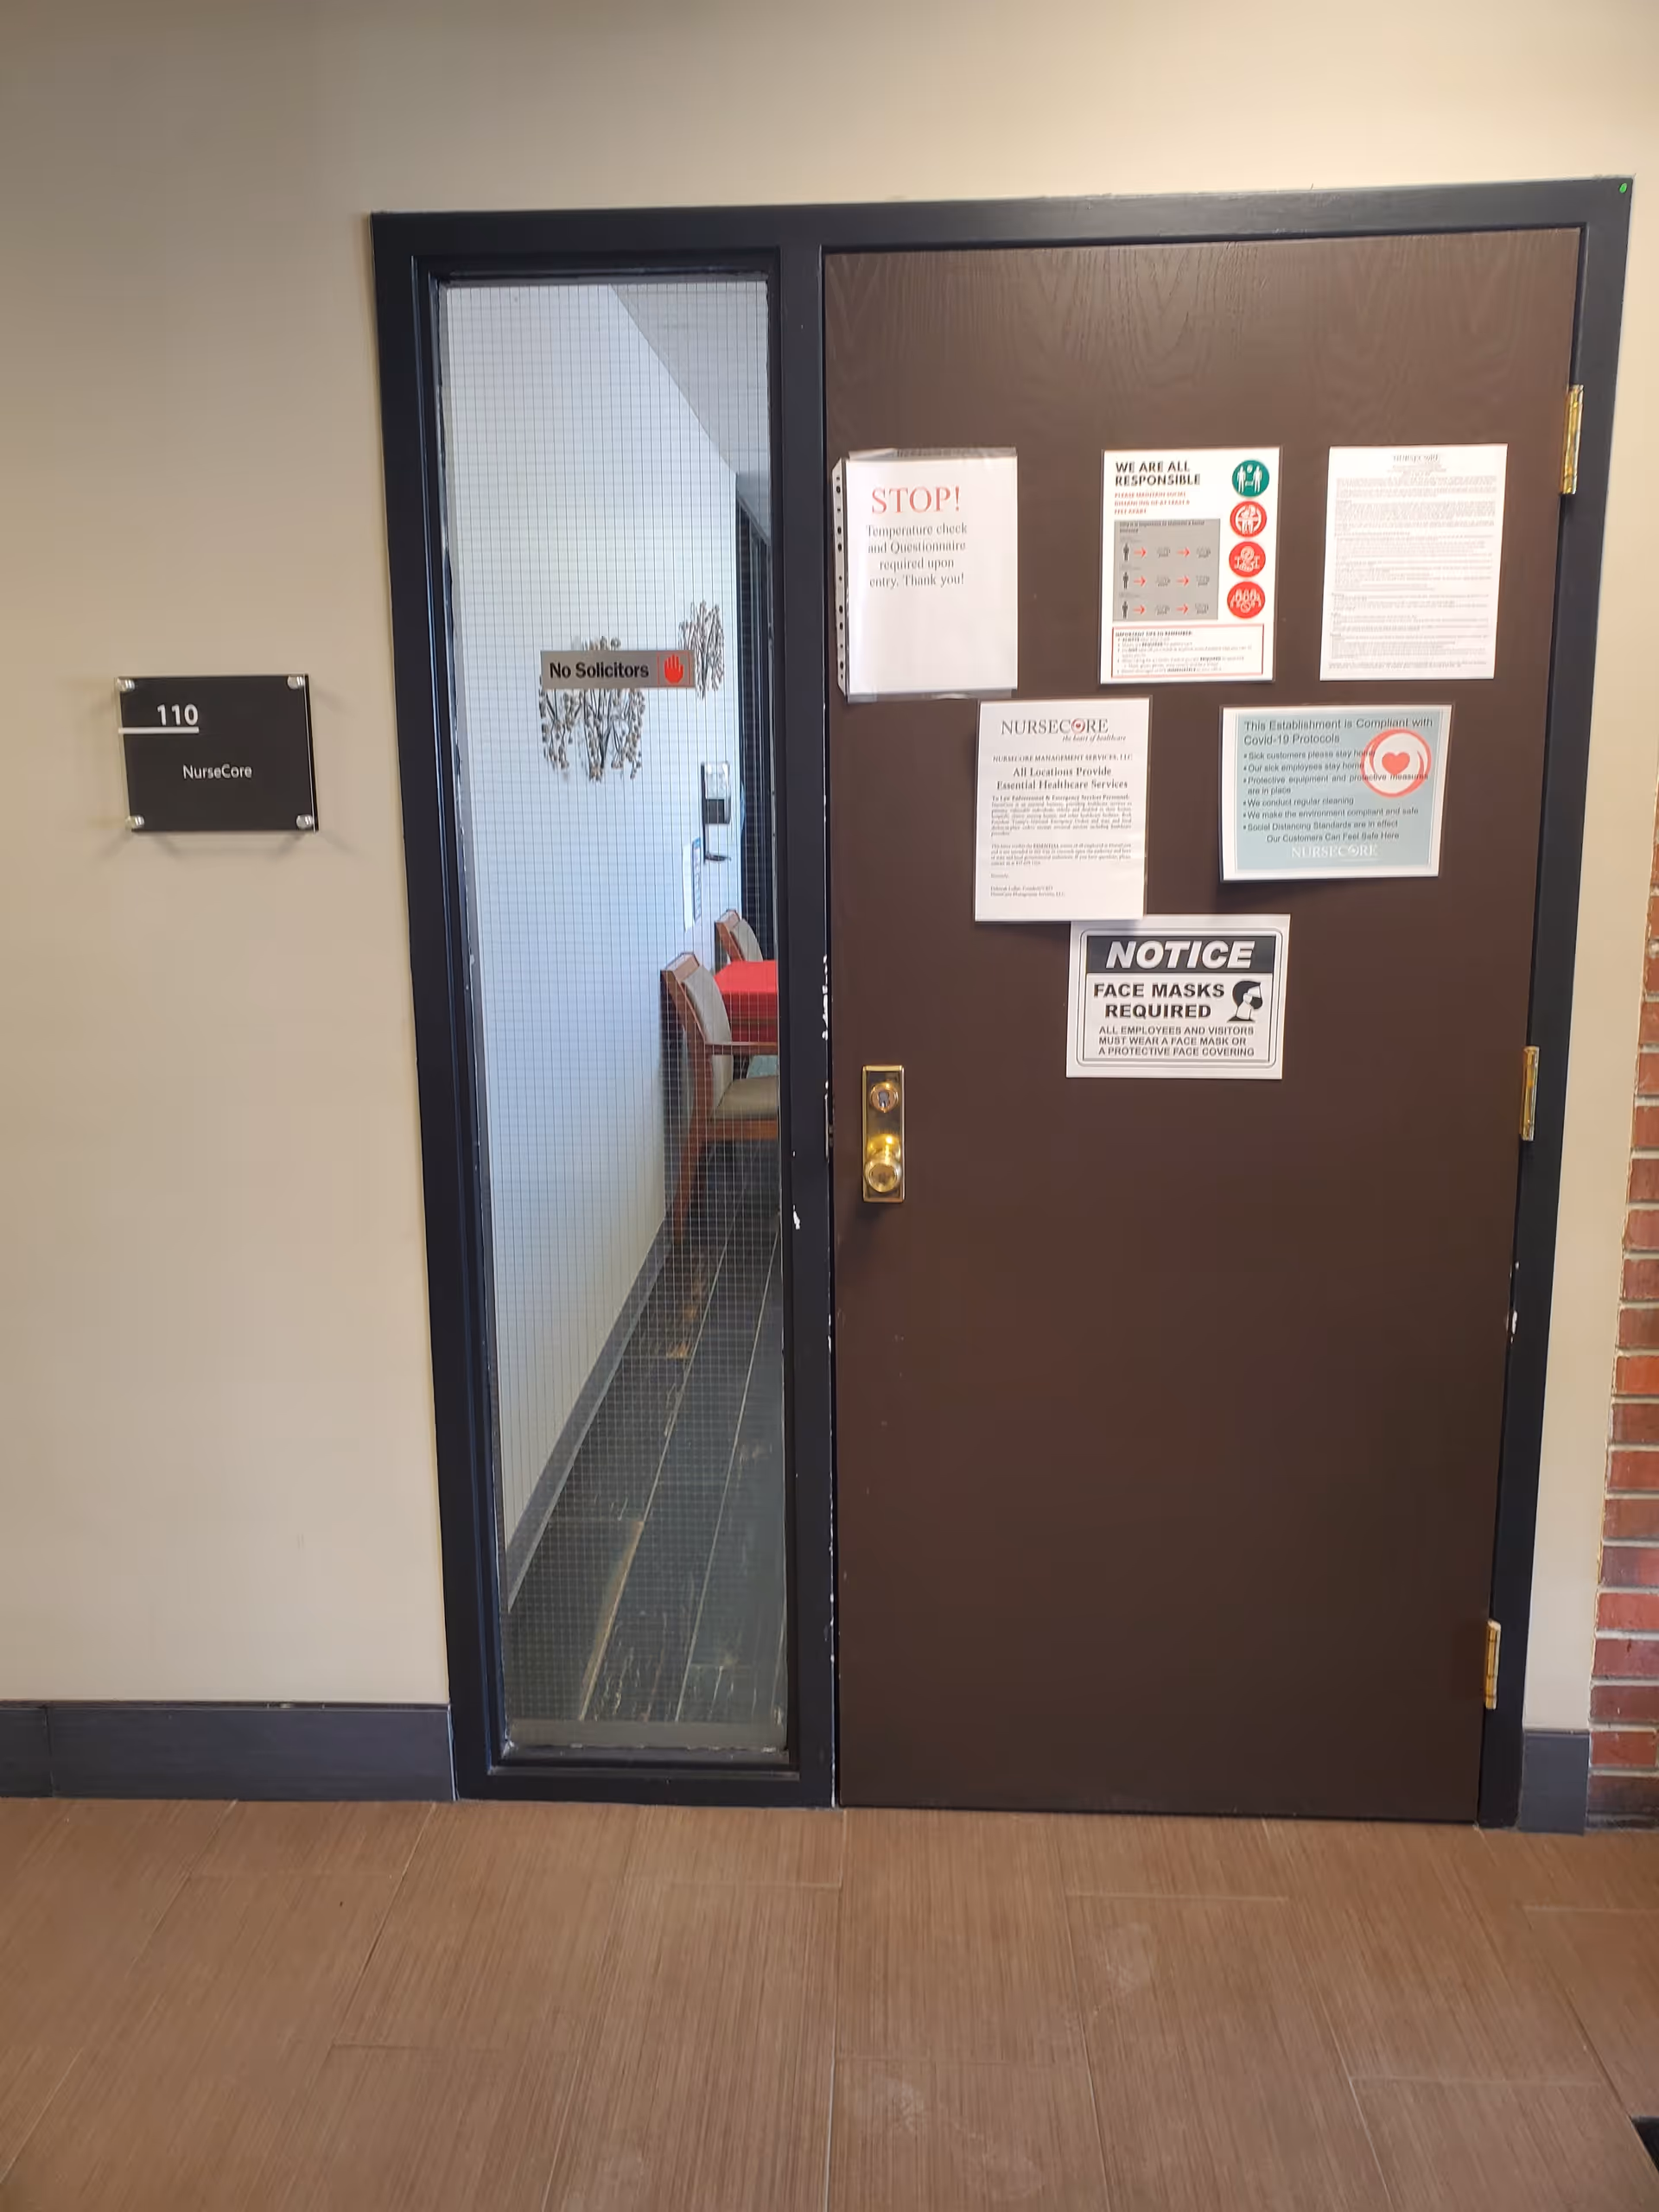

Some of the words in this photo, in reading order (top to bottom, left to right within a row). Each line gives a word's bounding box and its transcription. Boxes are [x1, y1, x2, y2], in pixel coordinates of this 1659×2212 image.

[1116, 461, 1135, 473] WE
[1139, 461, 1163, 473] ARE
[1167, 460, 1190, 472] ALL
[1116, 474, 1200, 486] RESPONSIBLE
[872, 486, 960, 514] STOP!
[866, 524, 932, 539] Temperature
[936, 522, 967, 534] check
[868, 542, 887, 553] and
[890, 540, 966, 554] Questionnaire
[880, 557, 924, 572] required
[928, 558, 954, 571] upon
[869, 575, 899, 588] entry.
[903, 575, 936, 586] Thank
[940, 573, 964, 588] you!
[550, 663, 571, 678] No
[575, 662, 649, 678] Solicitors
[157, 703, 199, 726] 110
[1001, 718, 1109, 735] NURSECORE
[1244, 720, 1266, 731] This
[1269, 719, 1341, 731] Establishment
[1344, 719, 1352, 728] is
[1356, 718, 1408, 731] Compliant
[1412, 718, 1433, 728] with
[1244, 734, 1289, 746] Covid-19
[1293, 733, 1340, 745] Protocols
[1267, 751, 1306, 760] customers
[1308, 750, 1333, 760] please
[182, 763, 253, 779] NurseCore
[1013, 767, 1027, 777] All
[1030, 766, 1073, 777] Locations
[1077, 766, 1112, 777] Provide
[1249, 763, 1262, 772] Our
[1281, 763, 1322, 772] employees
[1325, 762, 1340, 772] stay
[997, 780, 1035, 791] Essential
[1039, 779, 1089, 790] Healthcare
[1091, 779, 1128, 789] Services
[1249, 776, 1285, 785] Protective
[1289, 775, 1328, 785] equipment
[1349, 773, 1387, 783] protective
[1270, 786, 1291, 796] place
[1248, 798, 1260, 807] We
[1262, 798, 1292, 807] conduct
[1294, 798, 1320, 808] regular
[1323, 797, 1354, 805] cleaning
[1248, 810, 1260, 819] We
[1262, 810, 1282, 818] make
[1299, 809, 1344, 817] environment
[1348, 808, 1383, 817] compliant
[1248, 823, 1270, 831] Social
[1272, 822, 1311, 831] Distancing
[1313, 821, 1351, 830] Standards
[1377, 819, 1398, 828] effect
[1283, 834, 1322, 842] Customers
[1343, 832, 1359, 841] Feel
[1292, 843, 1378, 858] NURSECORE
[1105, 940, 1255, 969] NOTICE
[1094, 983, 1145, 998] FACE
[1152, 982, 1224, 998] MASKS
[1105, 1004, 1211, 1019] REQUIRED
[1099, 1026, 1118, 1035] ALL
[1121, 1026, 1182, 1035] EMPLOYEES
[1184, 1026, 1205, 1035] AND
[1209, 1026, 1254, 1035] VISITORS
[1099, 1037, 1126, 1046] MUST
[1129, 1037, 1160, 1046] WEAR
[1161, 1037, 1168, 1046] A
[1171, 1037, 1197, 1046] FACE
[1199, 1037, 1229, 1046] MASK
[1231, 1037, 1246, 1046] OR
[1098, 1047, 1106, 1056] A
[1108, 1047, 1170, 1056] PROTECTIVE
[1173, 1047, 1199, 1056] FACE
[1202, 1047, 1254, 1057] COVERING
